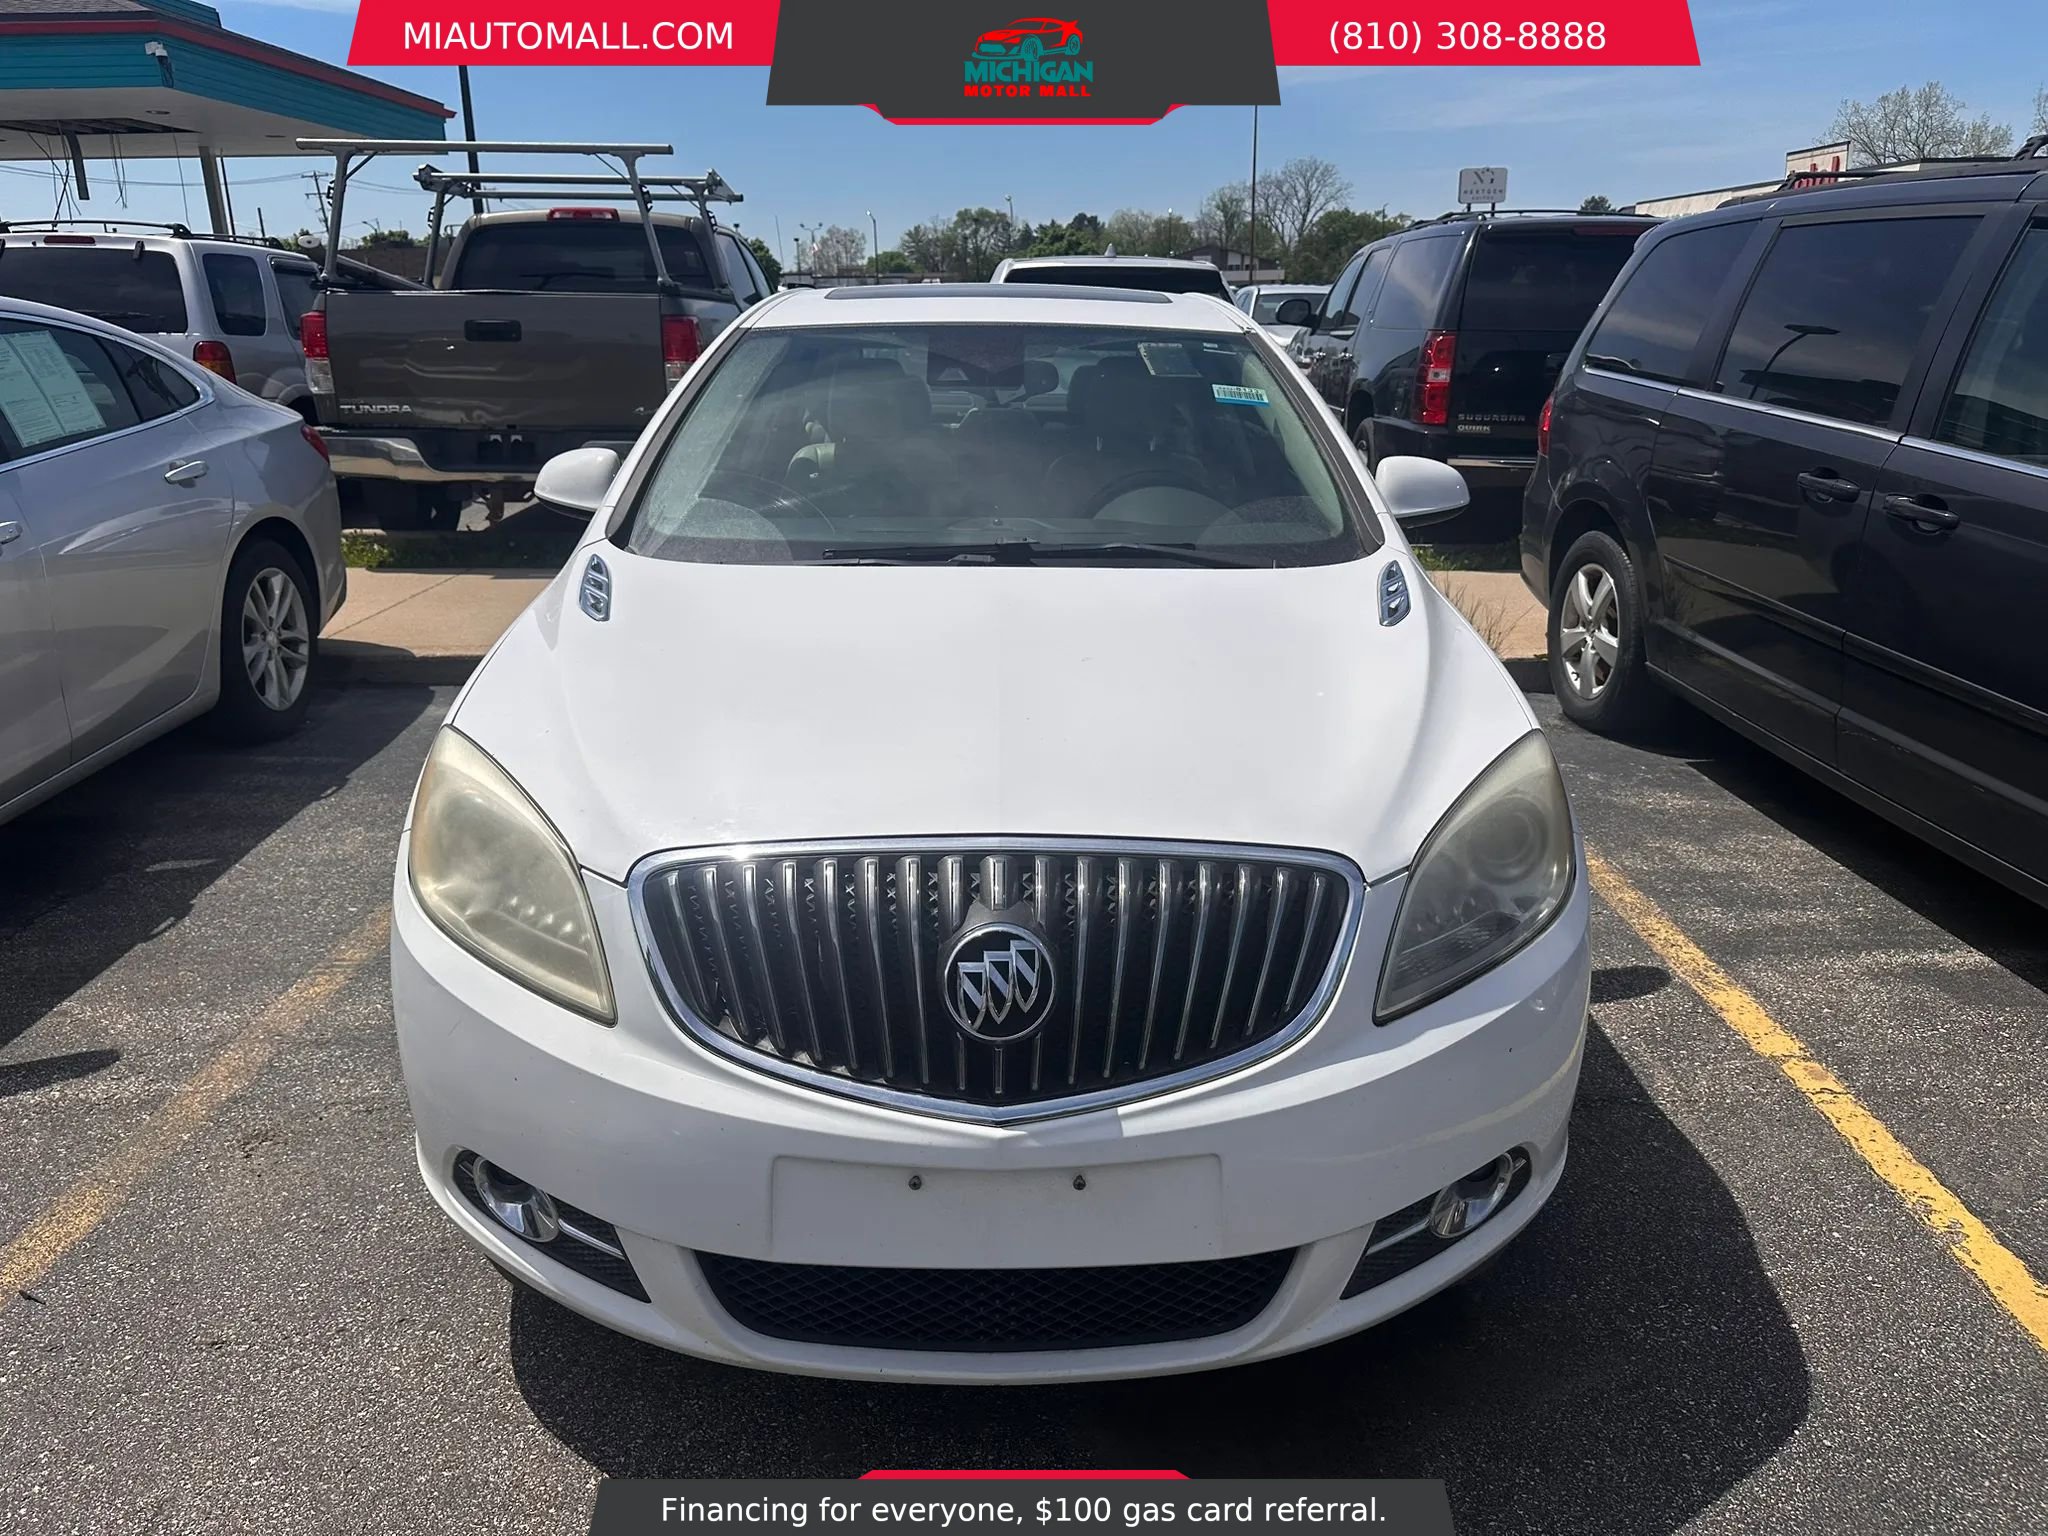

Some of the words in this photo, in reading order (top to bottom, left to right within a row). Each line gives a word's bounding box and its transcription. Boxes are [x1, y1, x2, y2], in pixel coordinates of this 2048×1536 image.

[339, 404, 414, 415] TUNDRA
[1458, 413, 1526, 422] SUBURBAN
[1457, 424, 1491, 433] QUIRK
